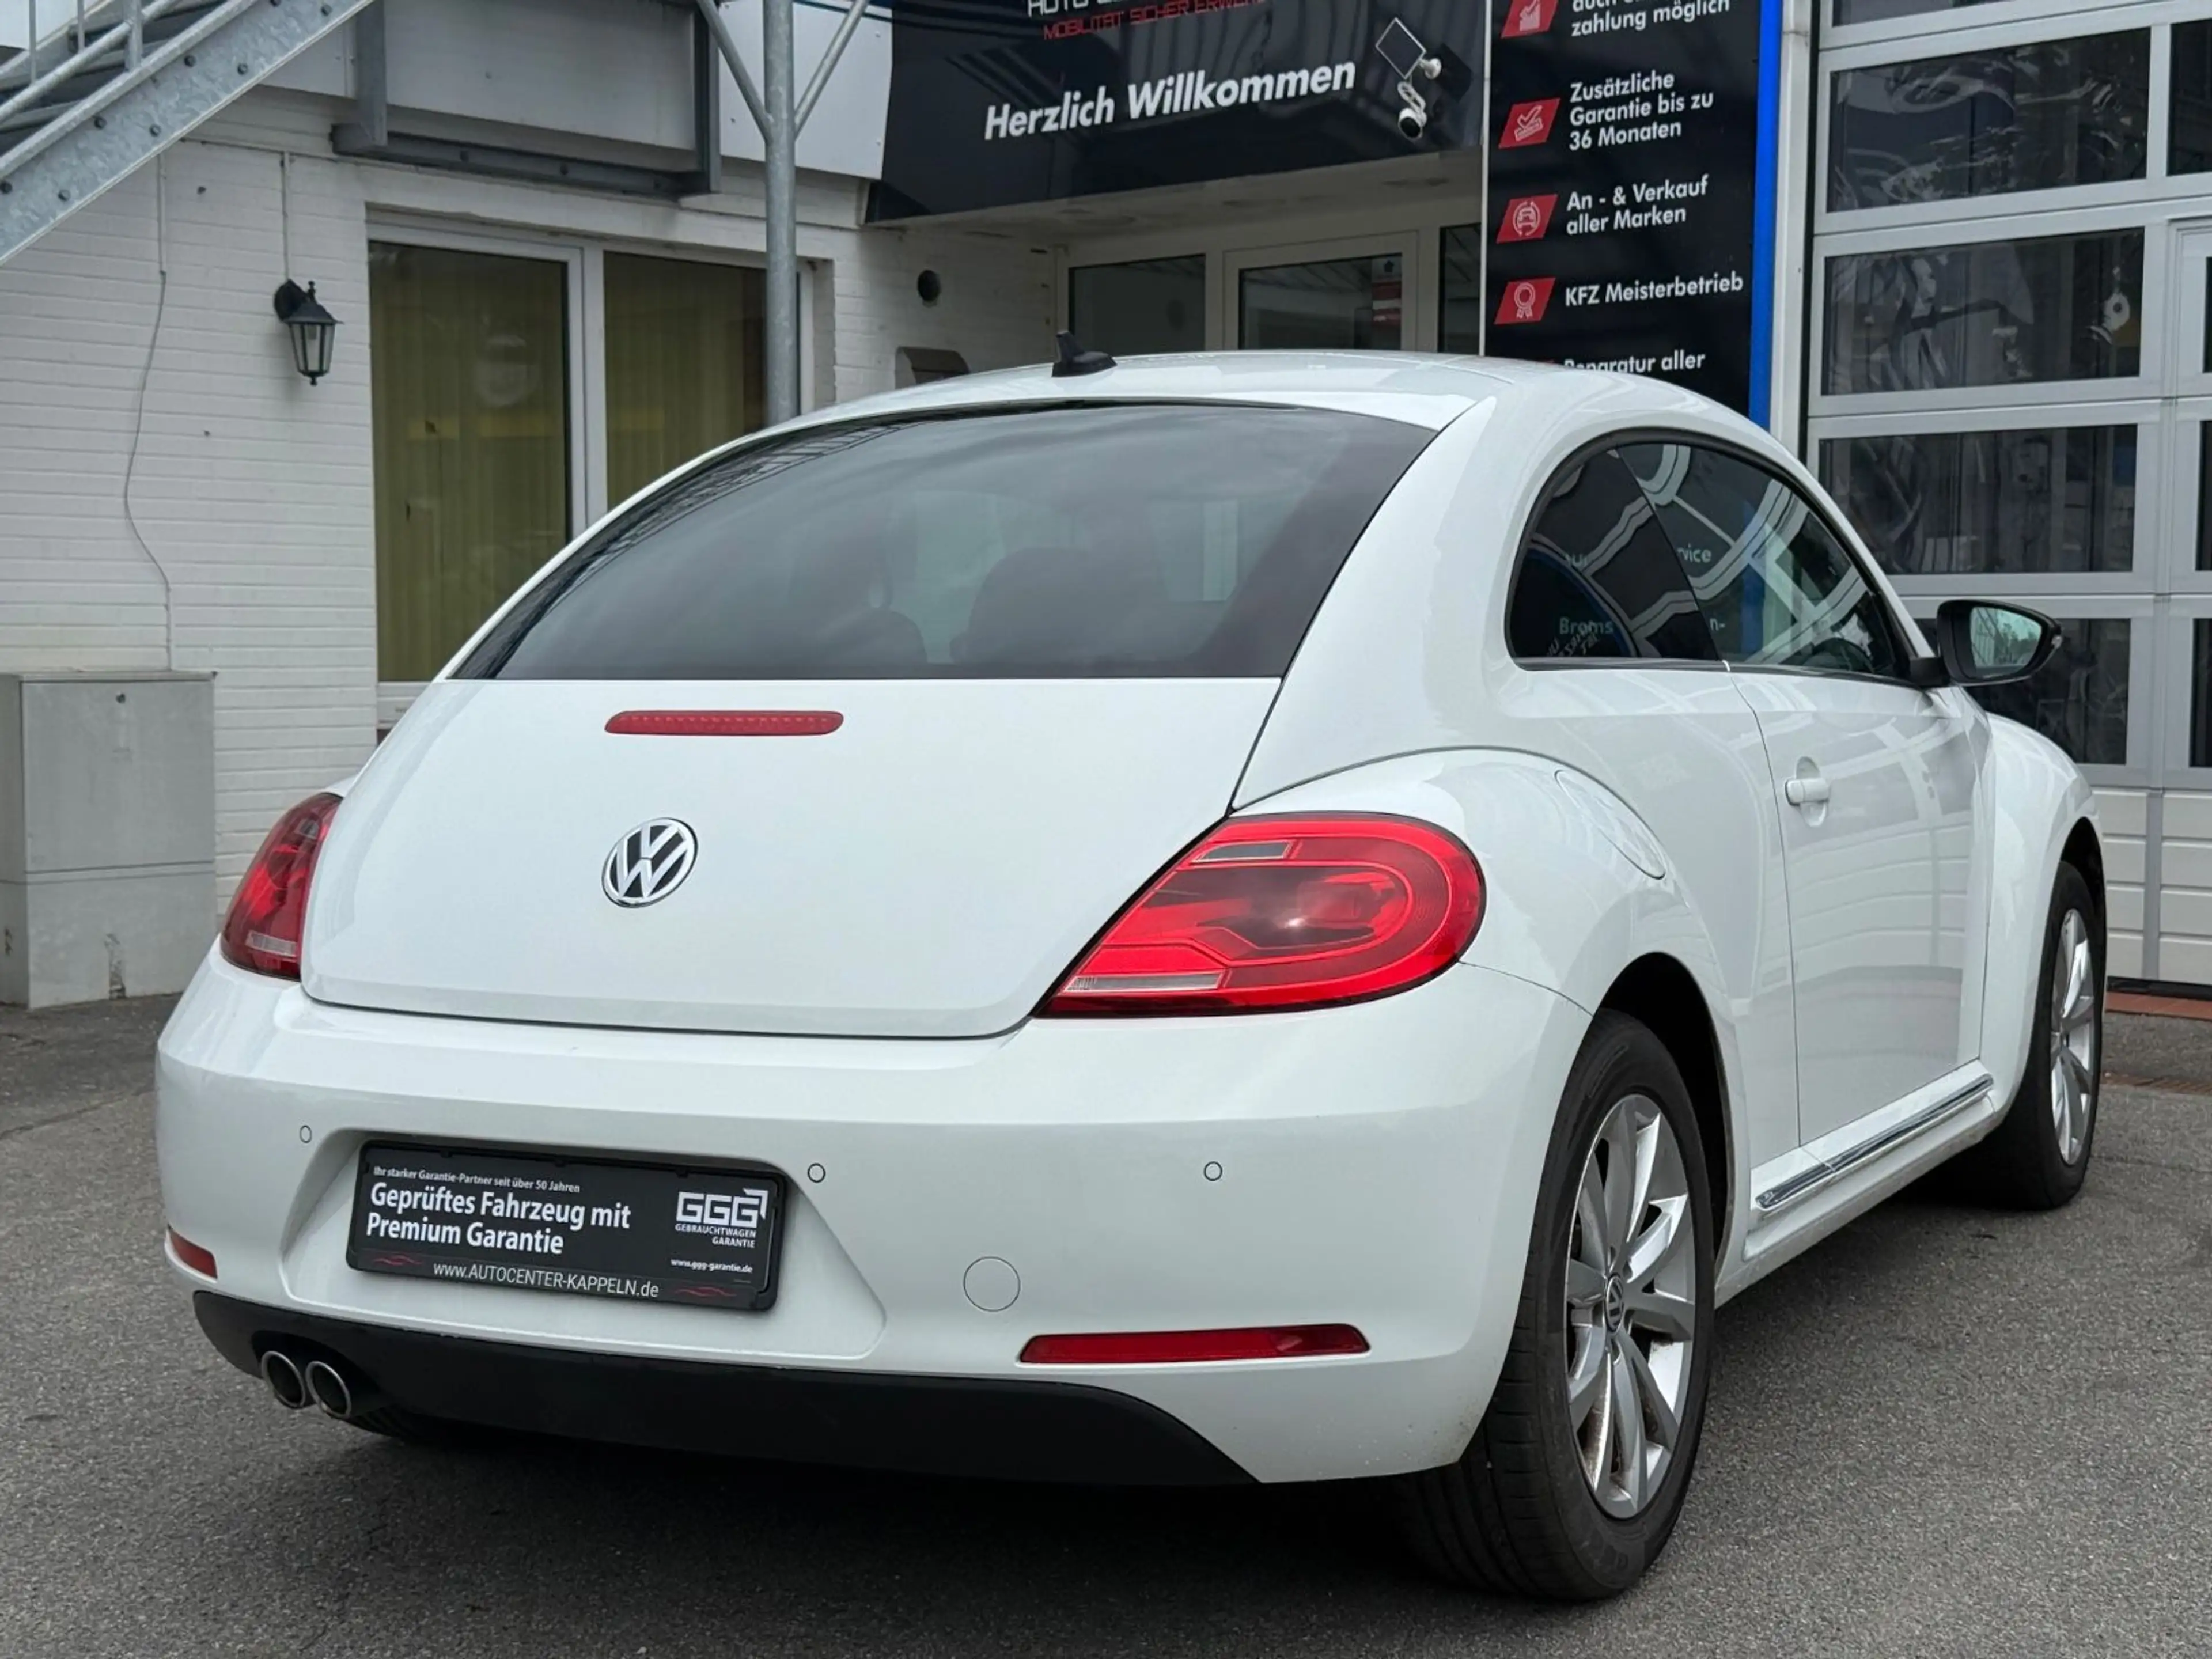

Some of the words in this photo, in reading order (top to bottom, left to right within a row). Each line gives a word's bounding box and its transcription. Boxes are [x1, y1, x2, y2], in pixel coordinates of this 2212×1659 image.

[1571, 10, 1646, 36] zahlung
[1653, 0, 1730, 23] möglich
[985, 86, 1114, 140] Herzlich
[1128, 62, 1355, 119] Willkommen
[1570, 70, 1675, 103] Zusätzliche
[1570, 97, 1652, 126] Garantie
[1657, 92, 1685, 115] bis
[1691, 93, 1714, 109] zu
[1569, 130, 1592, 151] 36
[1597, 121, 1682, 147] Monaten
[1566, 191, 1593, 211] An
[1613, 186, 1626, 206] &
[1632, 173, 1709, 203] Verkauf
[1566, 213, 1609, 235] aller
[1613, 204, 1687, 230] Marken
[1565, 285, 1600, 306] KFZ
[1605, 270, 1744, 304] Meisterbetrieb
[1661, 349, 1706, 370] aller
[374, 1166, 387, 1176] Ihr
[387, 1168, 417, 1179] starker
[418, 1170, 492, 1185] Garantie-Partner
[494, 1178, 510, 1187] seit
[512, 1177, 533, 1189] über
[535, 1179, 547, 1190] 50
[548, 1181, 581, 1193] Jahren
[370, 1181, 476, 1214] Geprüftes
[480, 1191, 586, 1231] Fahrzeug
[590, 1202, 632, 1229] mit
[366, 1211, 462, 1244] Premium
[467, 1221, 564, 1255] Garantie
[675, 1223, 757, 1238] GEBRAUCHTWAGEN
[711, 1236, 756, 1249] GARANTIE
[433, 1262, 660, 1298] www.AUTOCENTER-KAPPELN.de
[670, 1259, 753, 1274] www.ggg-garantie.de
